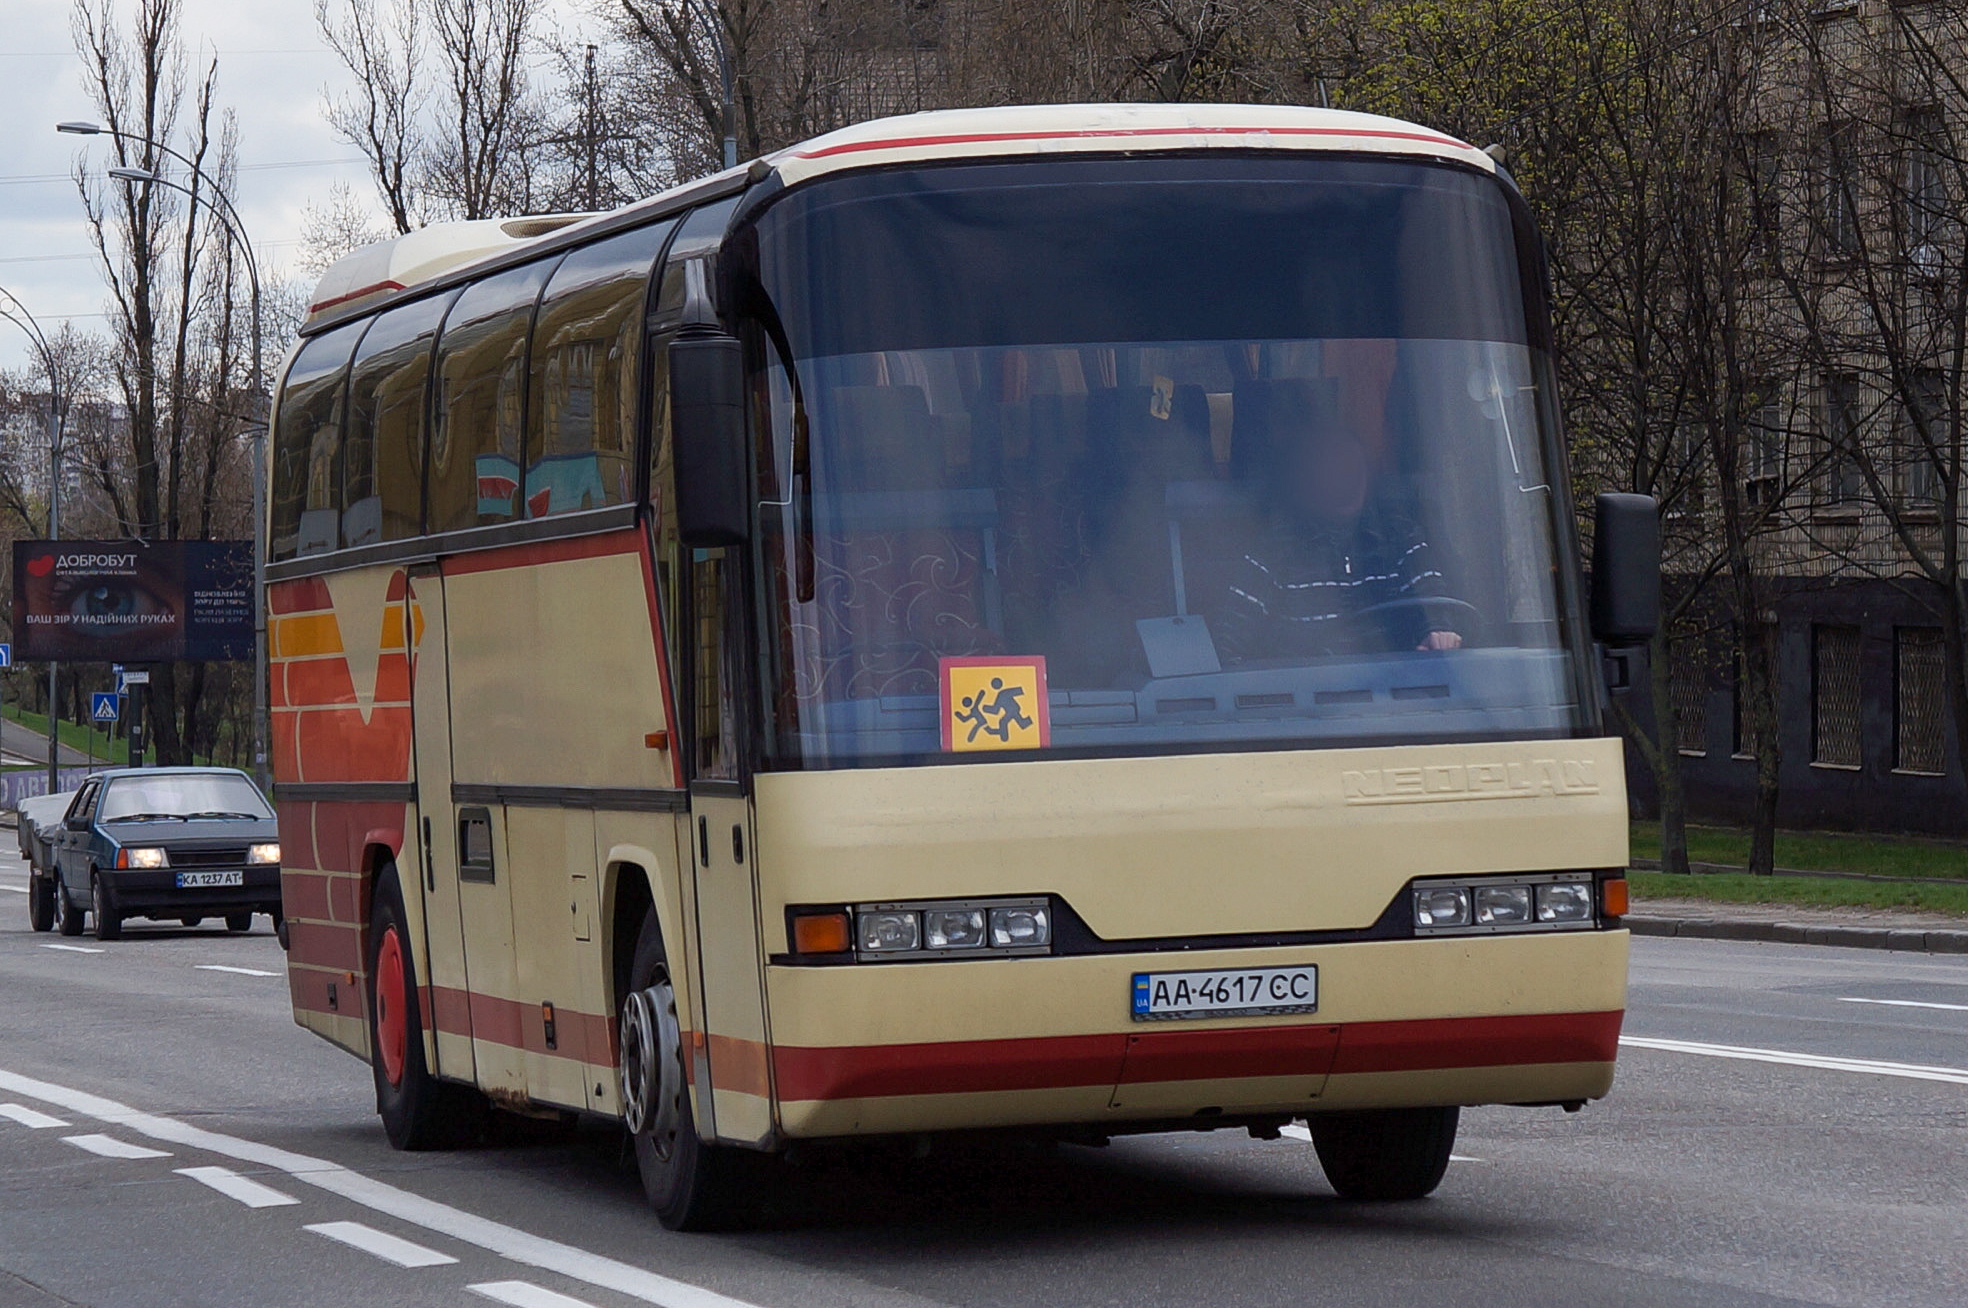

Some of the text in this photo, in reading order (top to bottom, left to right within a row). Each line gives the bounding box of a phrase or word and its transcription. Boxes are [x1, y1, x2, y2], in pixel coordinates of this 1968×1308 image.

[56, 554, 137, 568] ДОБРОБУТ
[26, 612, 175, 625] ВАШ ЗІР У НАДІЙНИХ РУКАХ
[1342, 758, 1599, 802] NEOPLAN
[183, 875, 198, 885] KA
[201, 873, 223, 884] 1237
[225, 873, 239, 884] AT
[1152, 979, 1192, 1007] AA
[1199, 975, 1263, 1004] 4617
[1136, 998, 1149, 1008] UA
